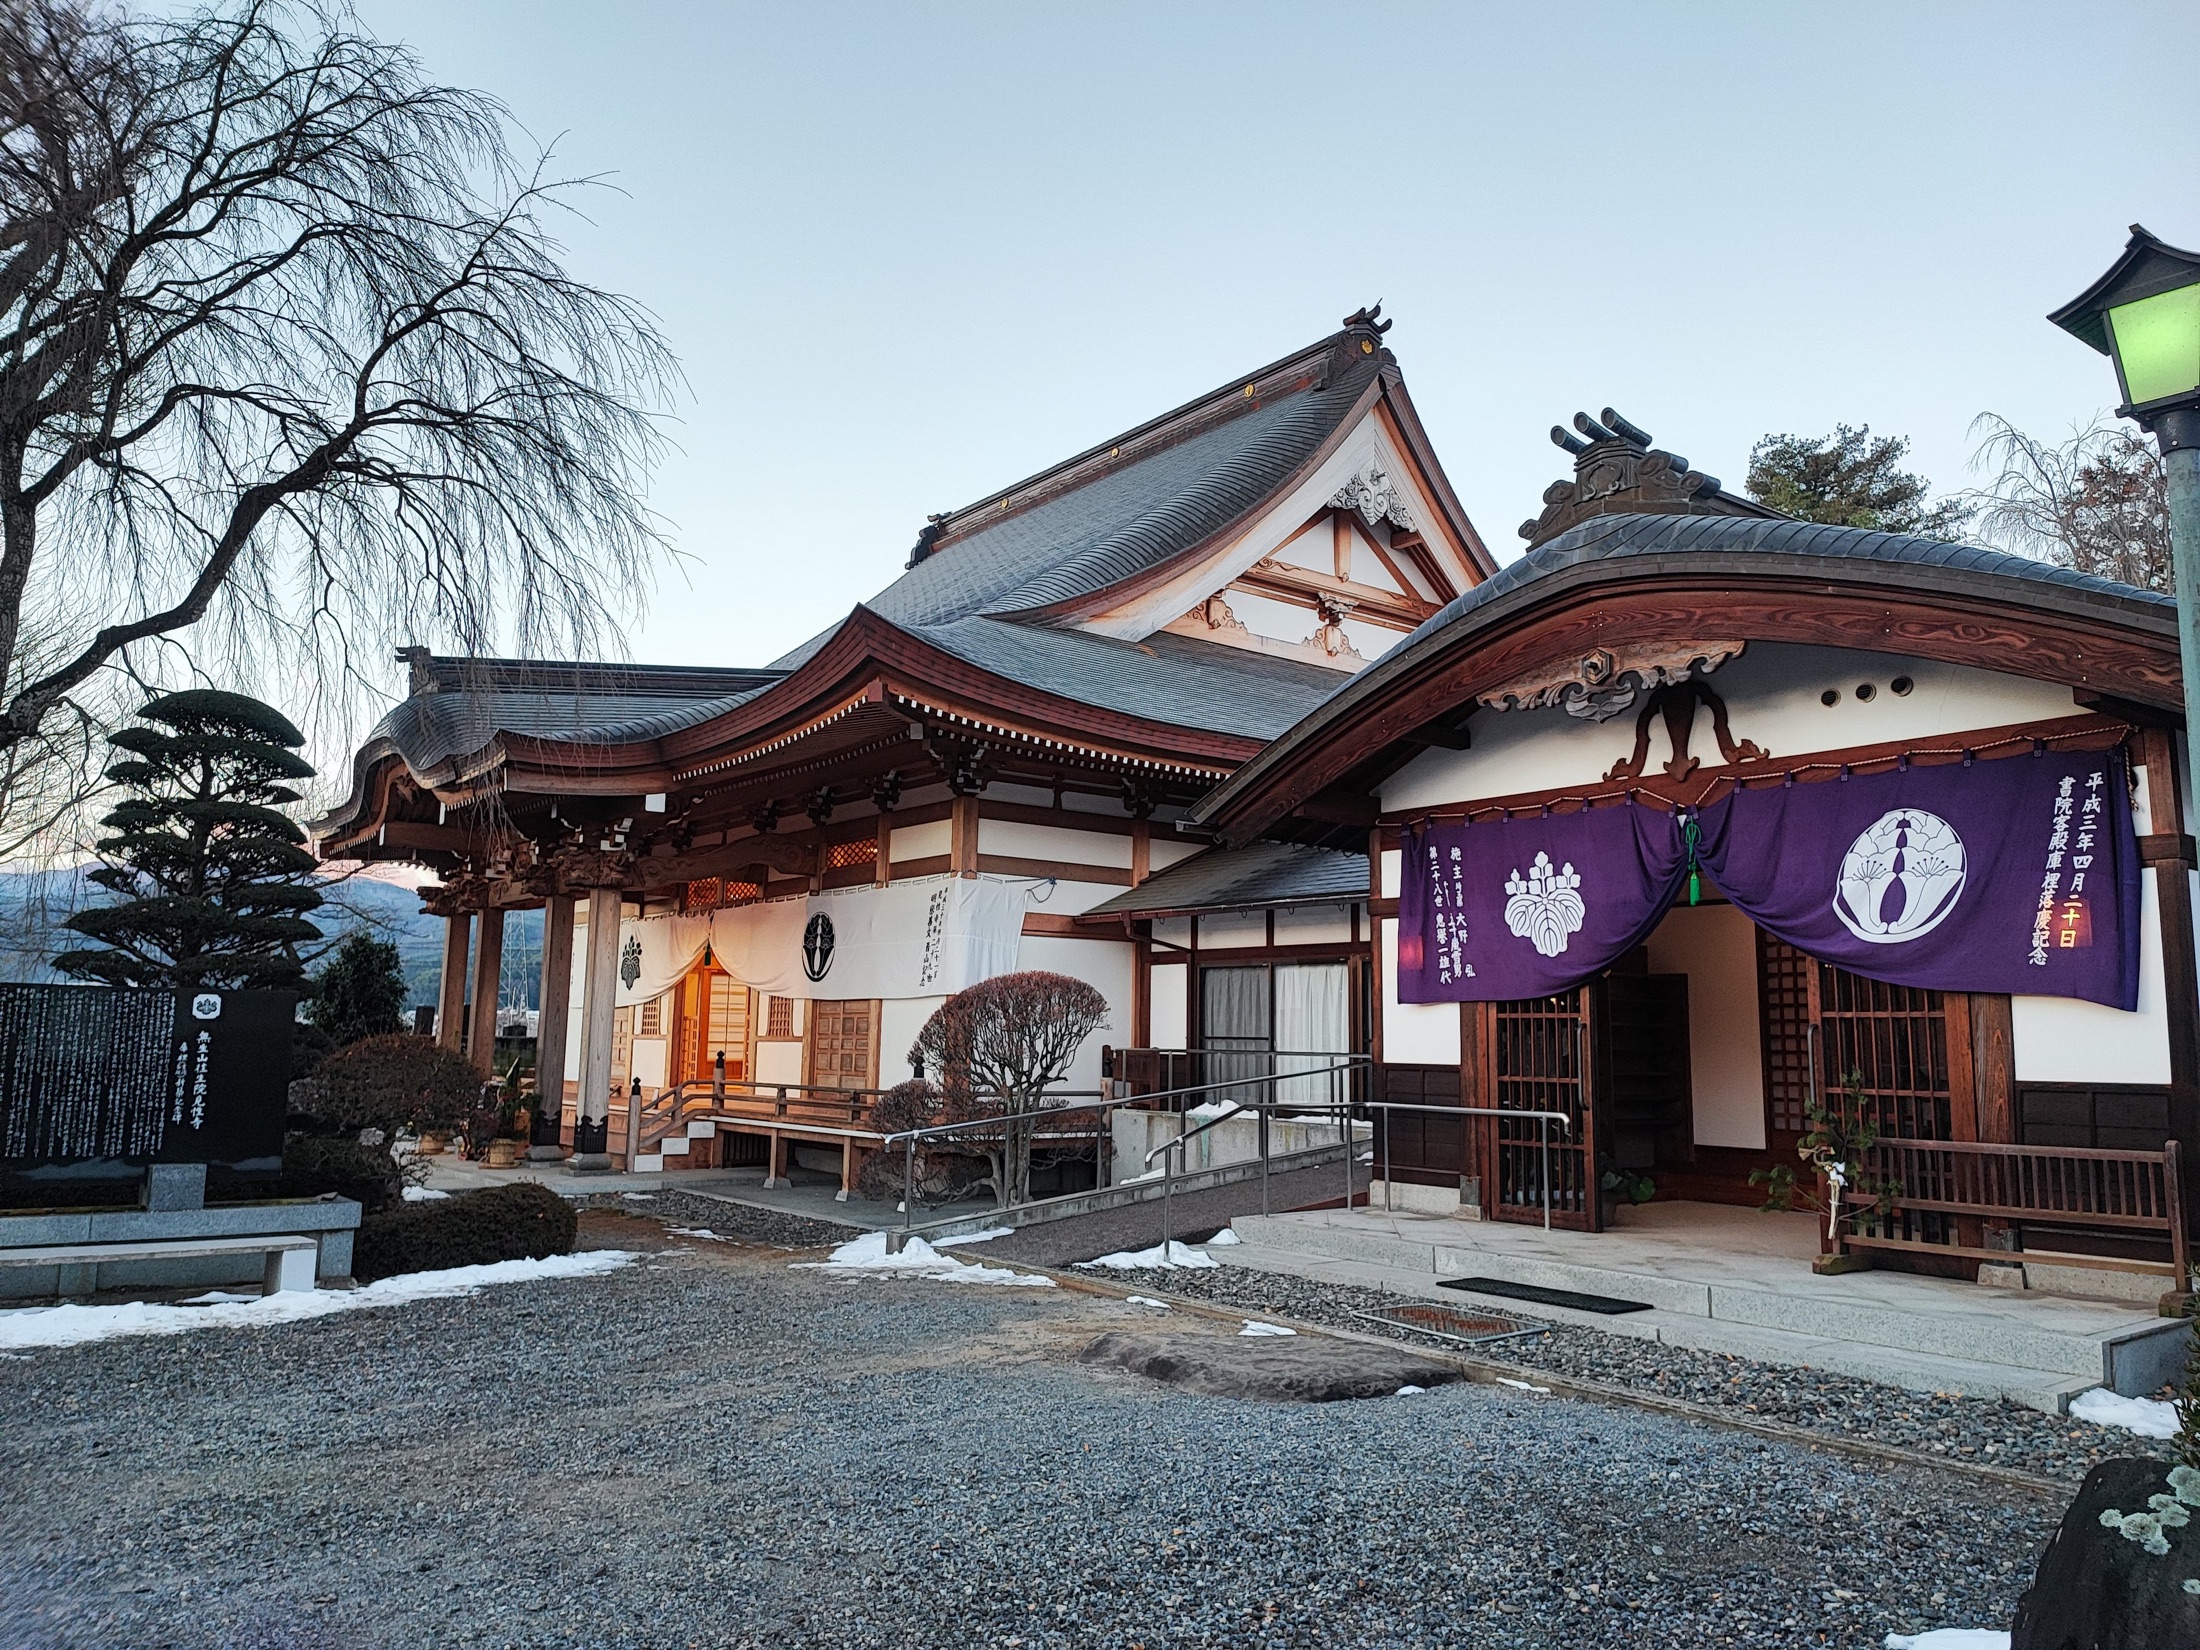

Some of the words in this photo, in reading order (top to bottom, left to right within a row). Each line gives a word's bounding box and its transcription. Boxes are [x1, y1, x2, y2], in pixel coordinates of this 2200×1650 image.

[2060, 771, 2104, 948] 平成三年四月二十日
